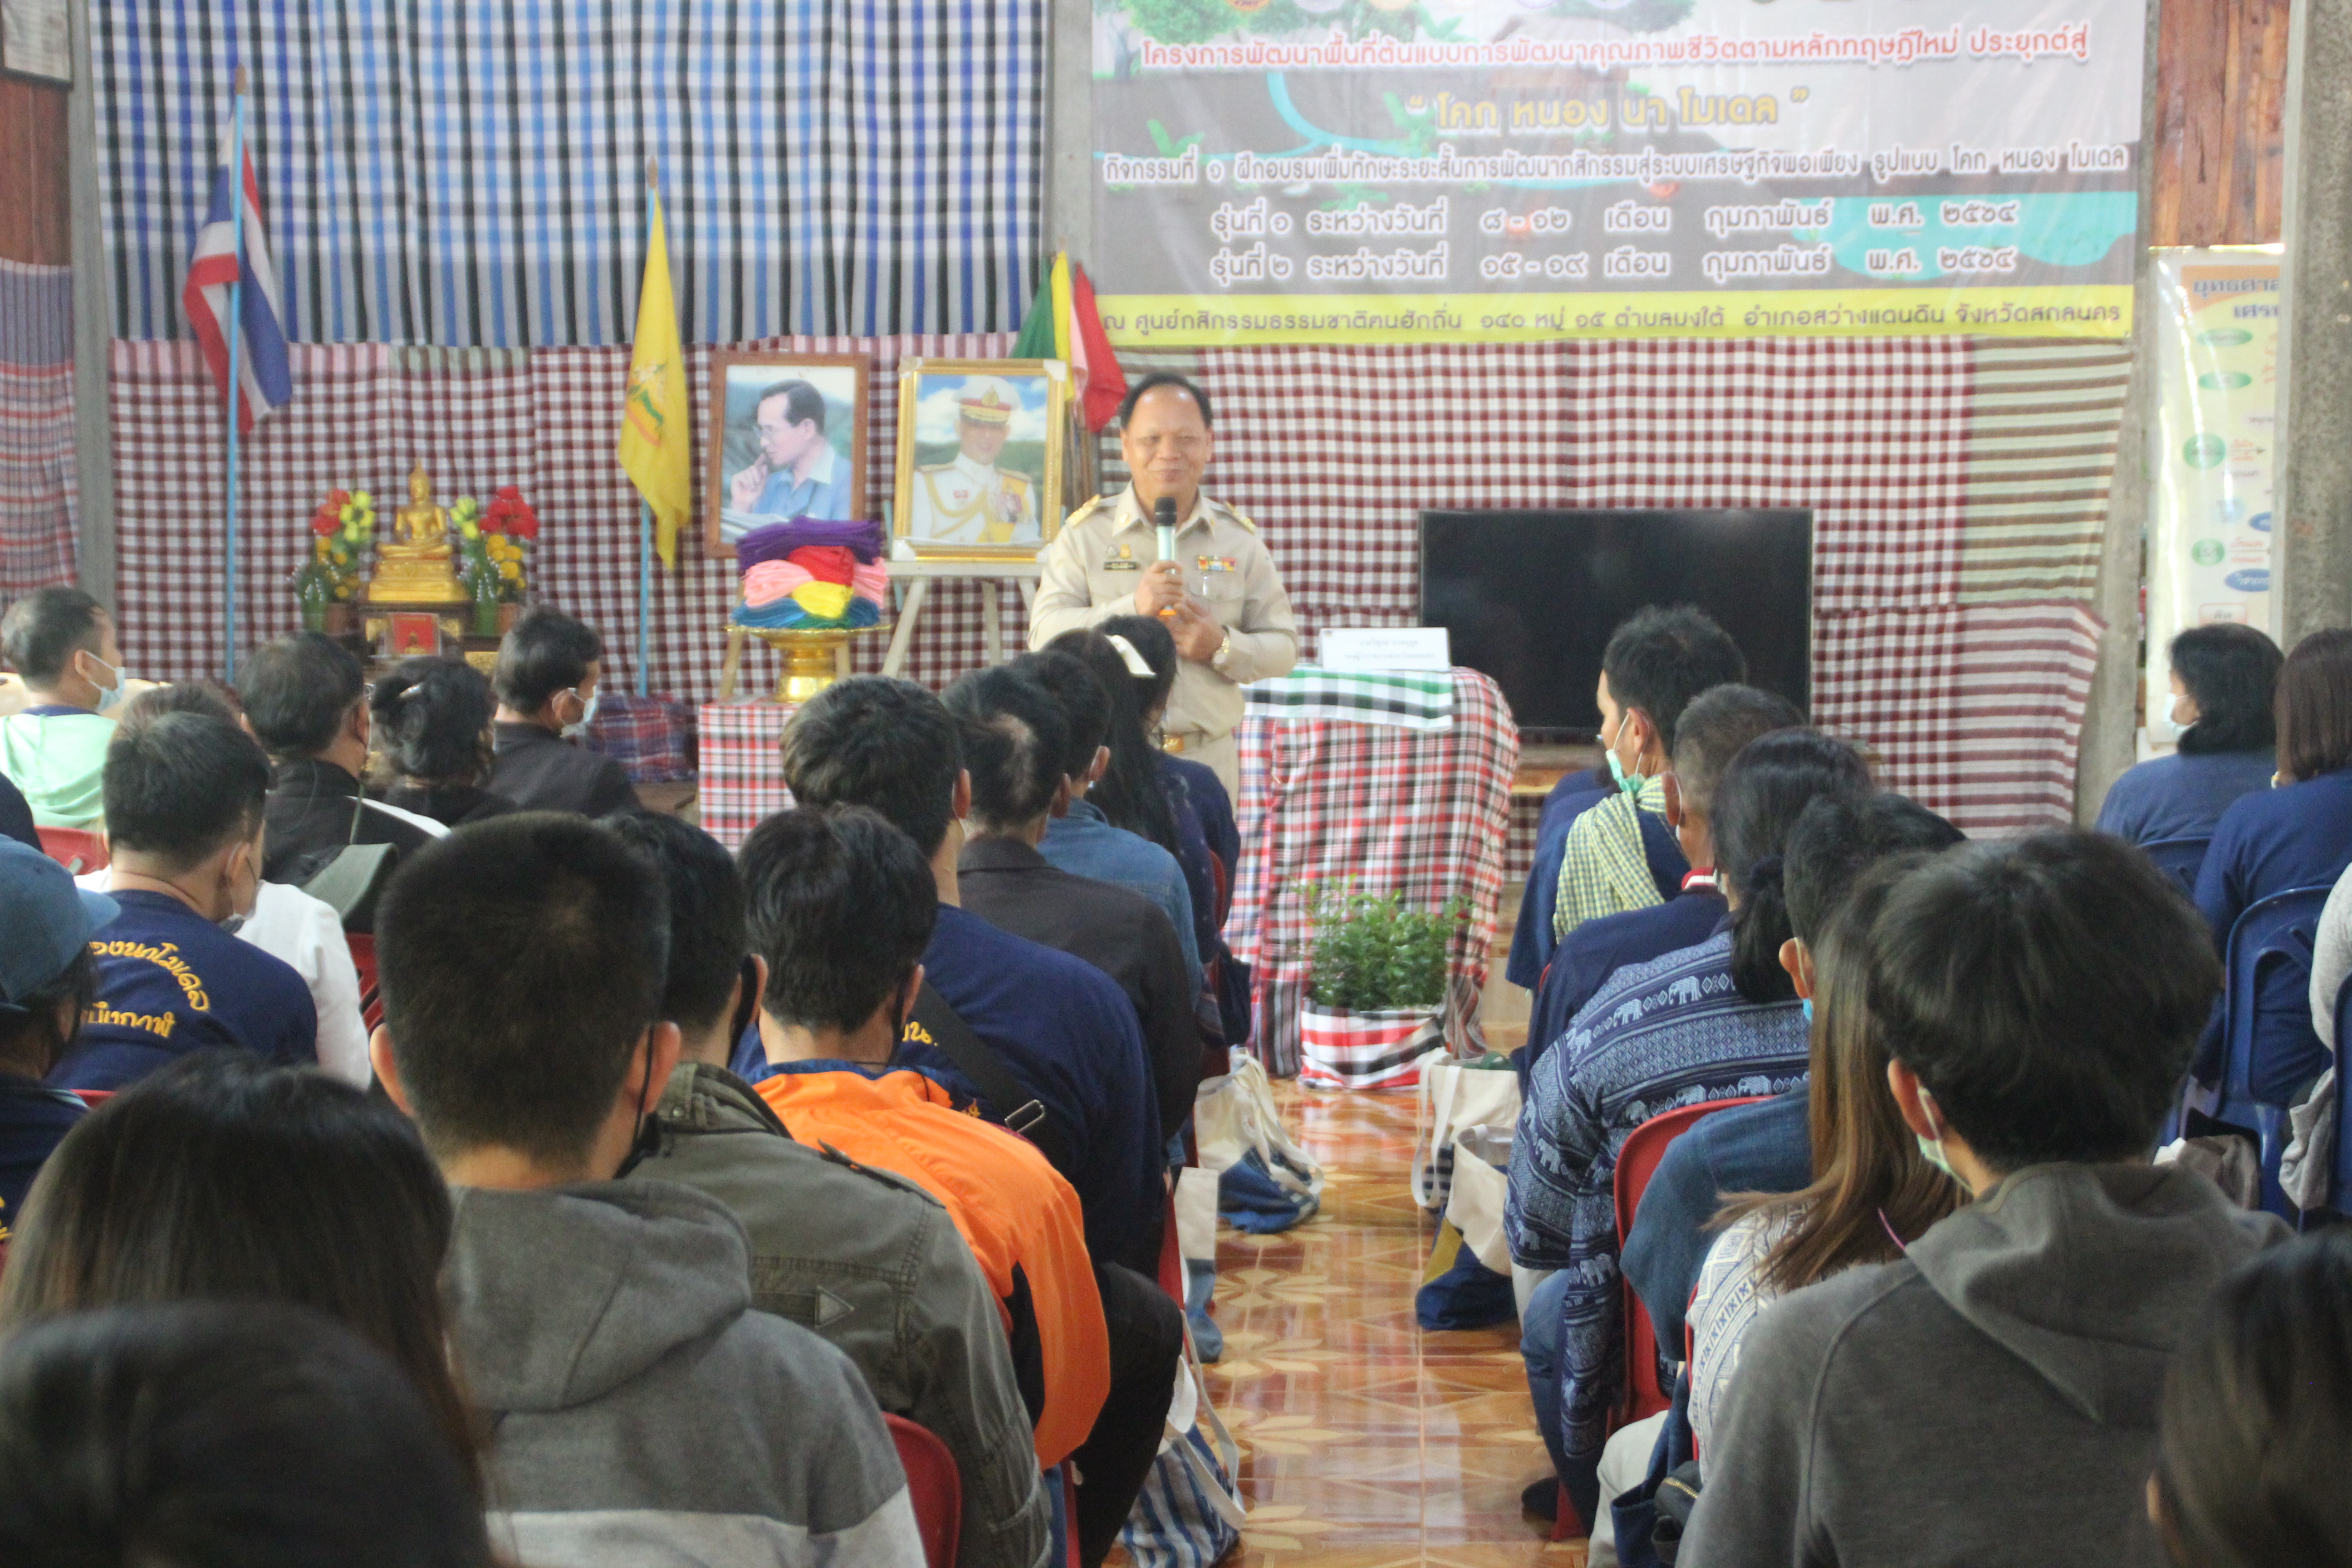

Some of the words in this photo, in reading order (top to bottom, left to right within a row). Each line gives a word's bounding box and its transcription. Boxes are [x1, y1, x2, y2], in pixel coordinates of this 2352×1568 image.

[1970, 23, 2088, 59] ประยุกต์สู่
[1437, 91, 1497, 127] โคก
[1513, 99, 1607, 127] หนอง
[1623, 96, 1666, 124] นา
[1679, 87, 1777, 123] โมเดล
[1105, 147, 1195, 179] กิจกรรมที่
[1209, 163, 1223, 179] ๑
[1874, 146, 1938, 180] รูปแบบ
[1952, 145, 1987, 170] โคก
[2003, 149, 2057, 170] หนอง
[2069, 142, 2126, 168] โมเดล
[1213, 199, 1264, 239] รุ่นที่
[1273, 214, 1290, 232] ๑
[1309, 199, 1447, 232] ระหว่างวันที่
[1607, 202, 1669, 230] เดือน
[1708, 200, 1832, 236] กุมภาพันธ์
[1871, 204, 1922, 225] พ.ศ.
[1942, 202, 2017, 224] ๒๕๖๔
[1212, 244, 1263, 284] รุ่นที่
[1273, 256, 1290, 275] ๒
[1309, 244, 1447, 276] ระหว่างวันที่
[1607, 247, 1668, 275] เดือน
[1706, 245, 1830, 281] กุมภาพันธ์
[1869, 251, 1919, 270] พ.ศ.
[1940, 250, 2014, 269] ๒๕๖๔
[1103, 314, 1126, 330] ณ
[1480, 313, 1526, 329] ๑๔๐
[1534, 305, 1565, 332] หมู่
[1575, 311, 1607, 328] ๑๕
[1614, 304, 1725, 328] ตำบลบงใต้
[1743, 303, 1945, 326] อำเภอสว่างแดนดิน
[1955, 301, 2121, 323] จังหวัดสกลนคร
